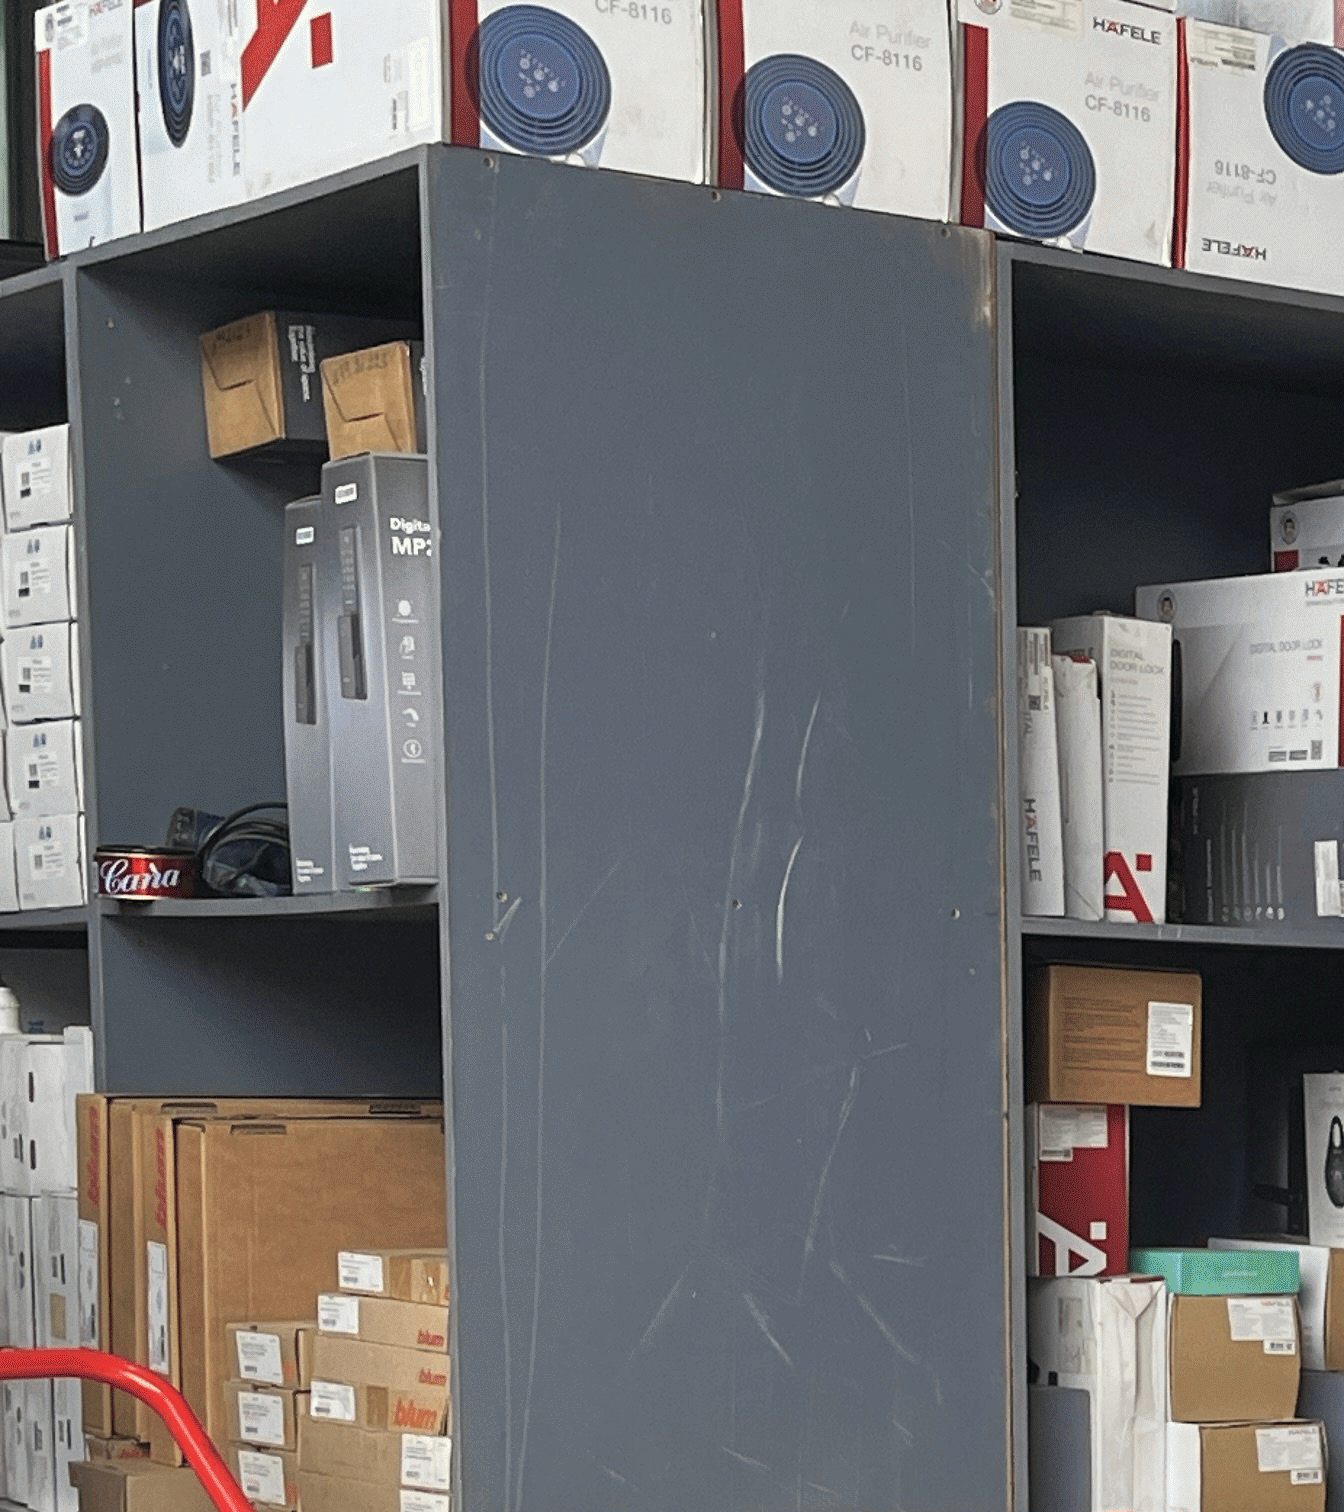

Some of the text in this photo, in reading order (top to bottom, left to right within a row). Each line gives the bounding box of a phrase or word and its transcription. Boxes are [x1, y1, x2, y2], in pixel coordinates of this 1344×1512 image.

[850, 44, 924, 72] CF-8116
[1084, 94, 1152, 123] CF-8116
[1213, 159, 1278, 185] CF-8116
[389, 517, 432, 535] Digita
[394, 1397, 438, 1431] blum
